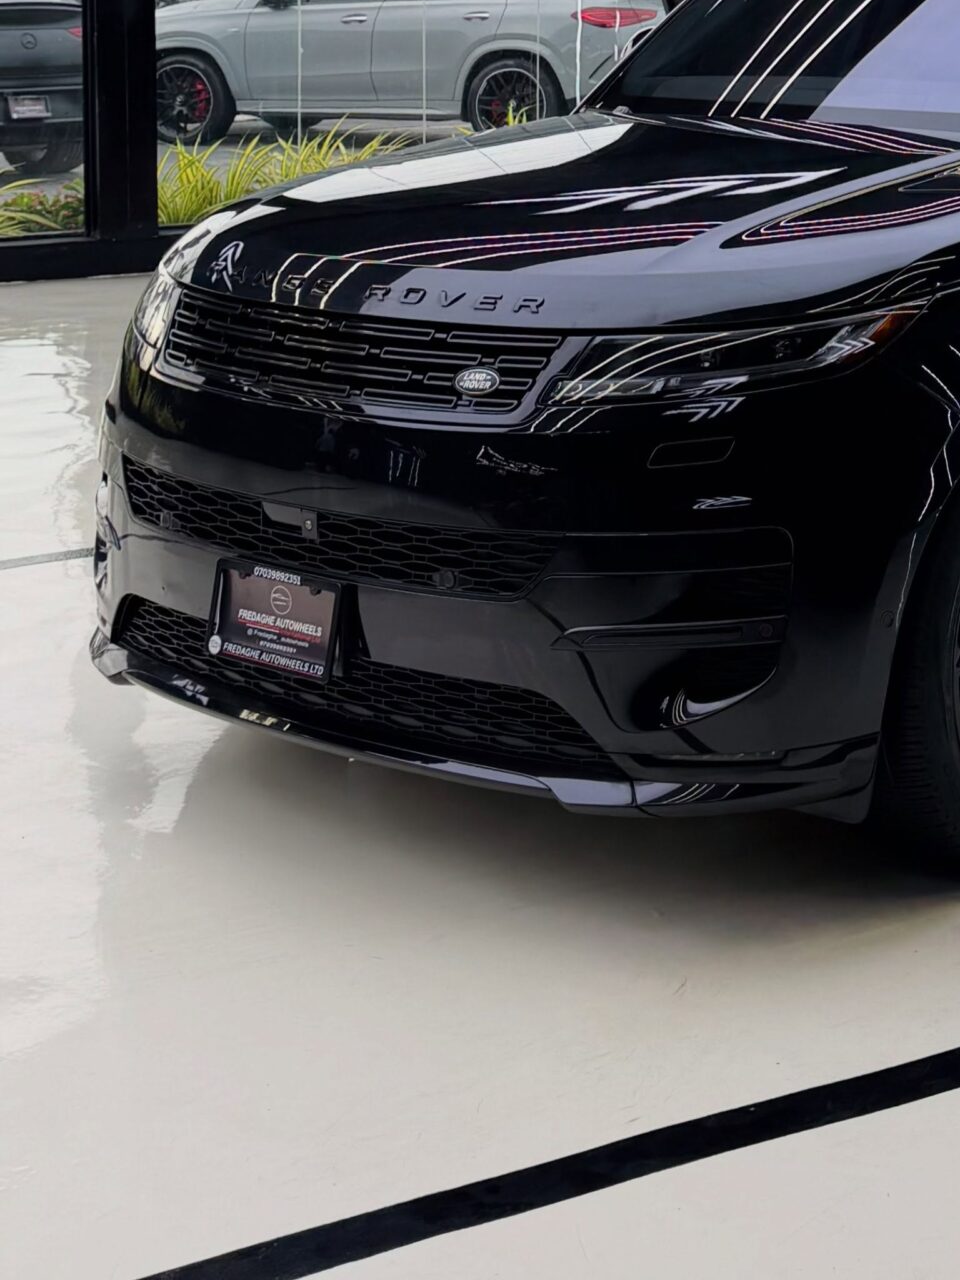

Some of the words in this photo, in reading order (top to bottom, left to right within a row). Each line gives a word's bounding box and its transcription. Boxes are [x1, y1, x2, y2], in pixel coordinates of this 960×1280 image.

[364, 284, 545, 314] ROVER
[238, 609, 275, 626] FREDAGHE
[275, 618, 322, 637] AUTOWHEELS
[223, 642, 260, 659] FREDAGHE
[261, 653, 309, 671] AUTOWHEELS
[309, 664, 324, 675] LTD
